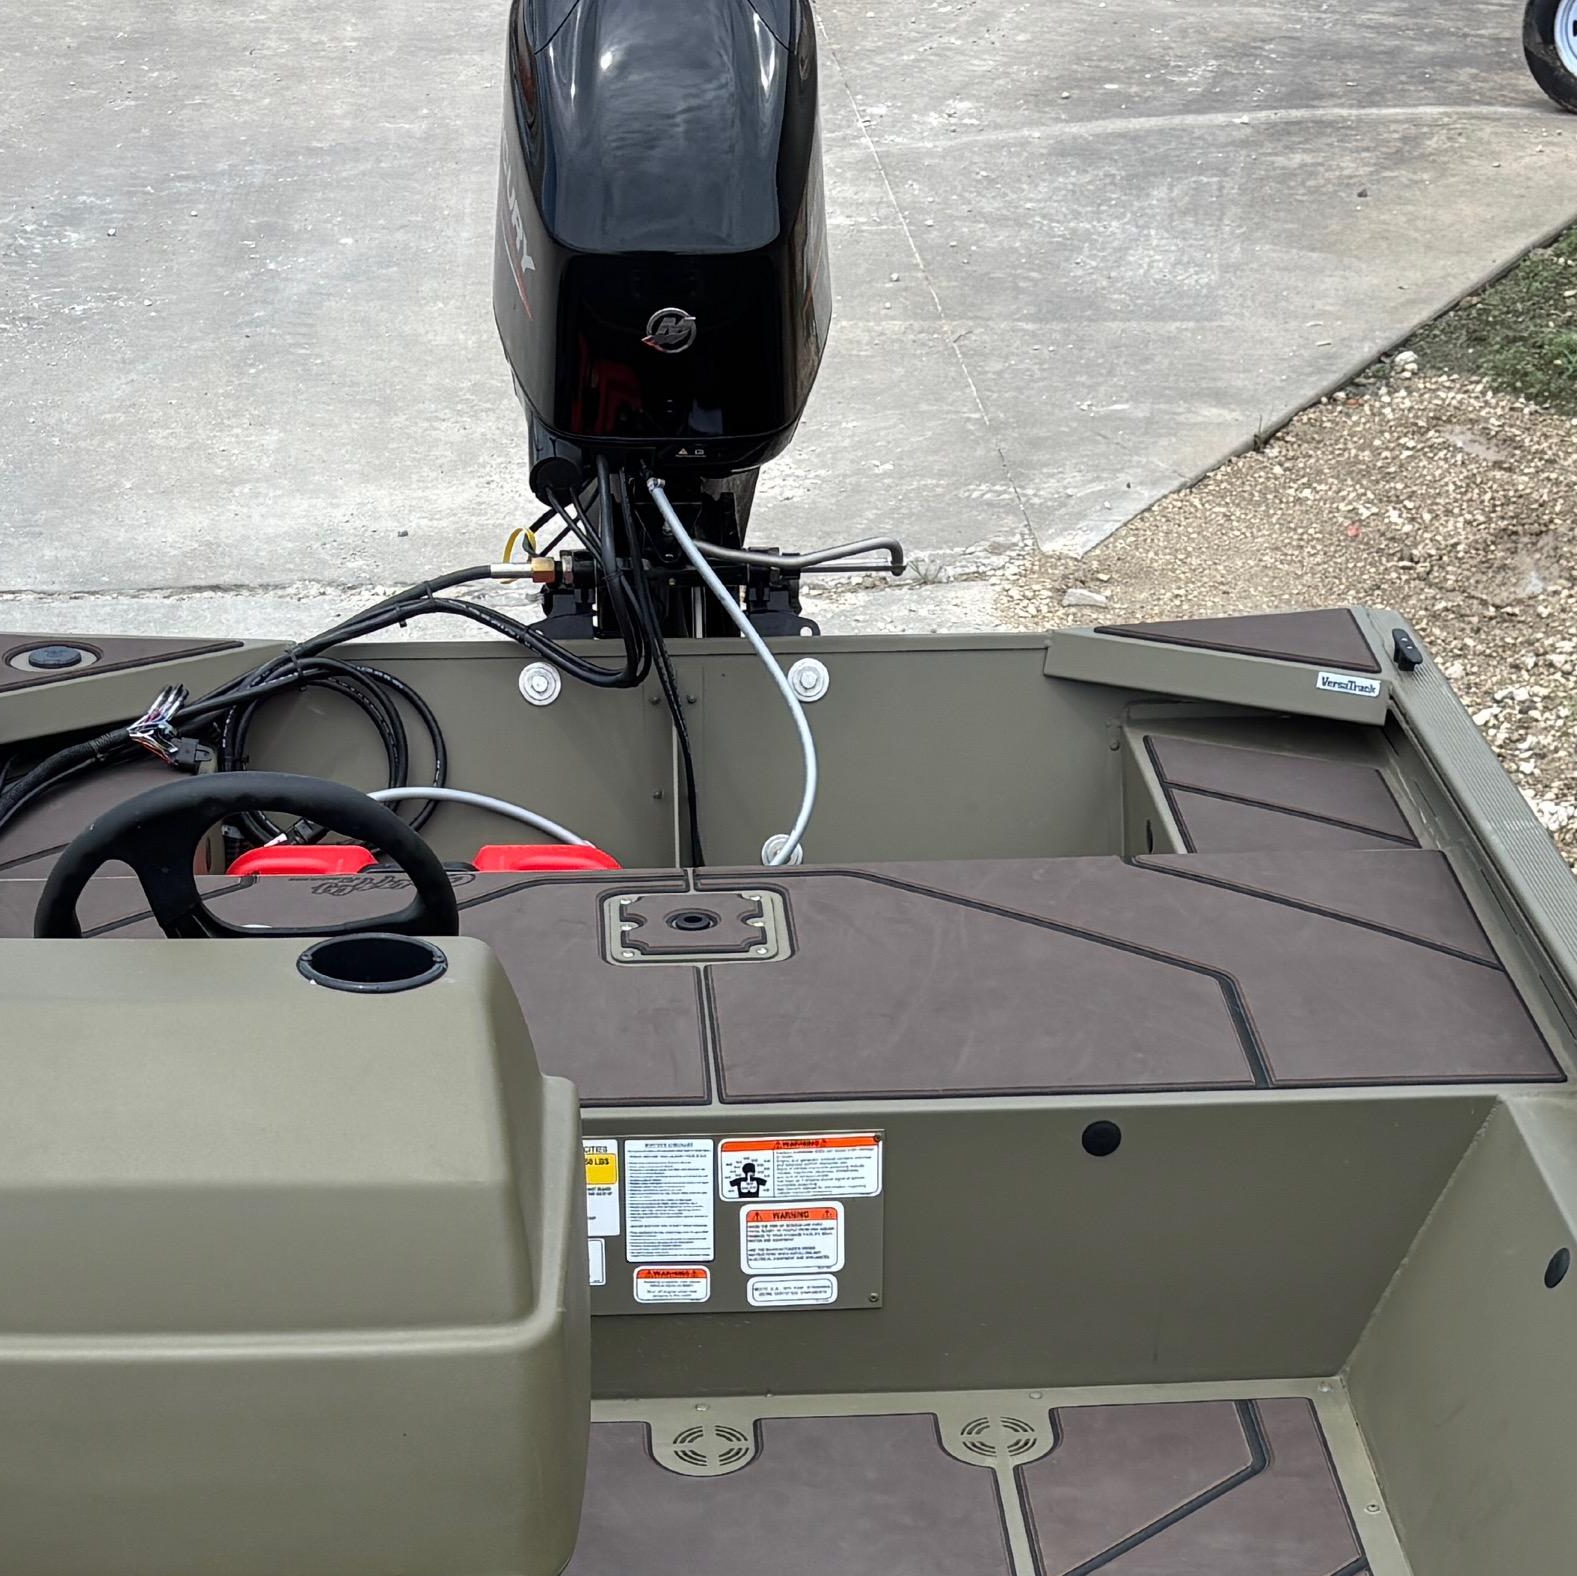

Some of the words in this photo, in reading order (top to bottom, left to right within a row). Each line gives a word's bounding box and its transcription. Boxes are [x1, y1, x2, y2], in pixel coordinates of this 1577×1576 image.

[502, 129, 536, 273] CURY
[1321, 676, 1377, 694] VersaTrack
[773, 1210, 810, 1220] WARNING
